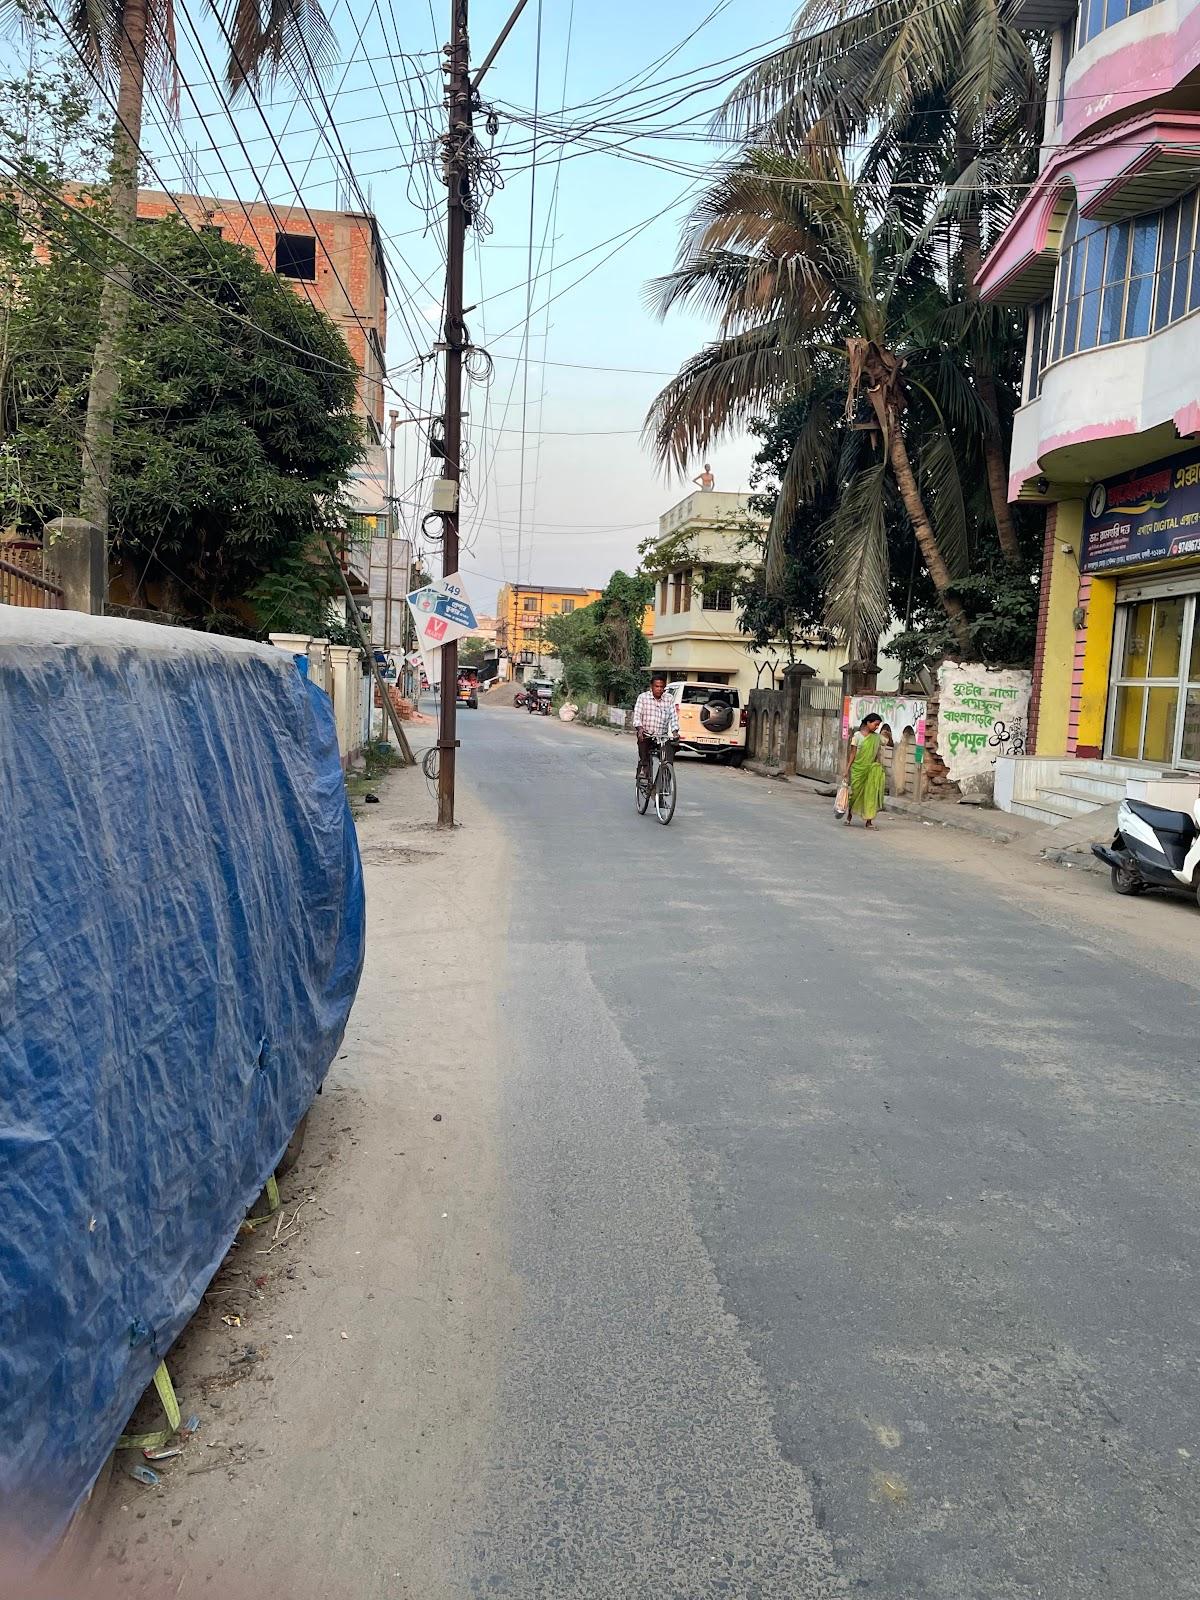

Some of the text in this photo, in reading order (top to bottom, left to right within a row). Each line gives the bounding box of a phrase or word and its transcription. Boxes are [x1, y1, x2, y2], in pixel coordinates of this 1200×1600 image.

[1174, 464, 1200, 489] এক্স
[1153, 518, 1178, 532] DIGITAL
[444, 583, 460, 596] 149
[434, 618, 444, 631] V
[952, 681, 985, 697] ফুটবে
[961, 697, 1003, 714] পদ্মফুল
[948, 732, 988, 757] তৃণমূল
